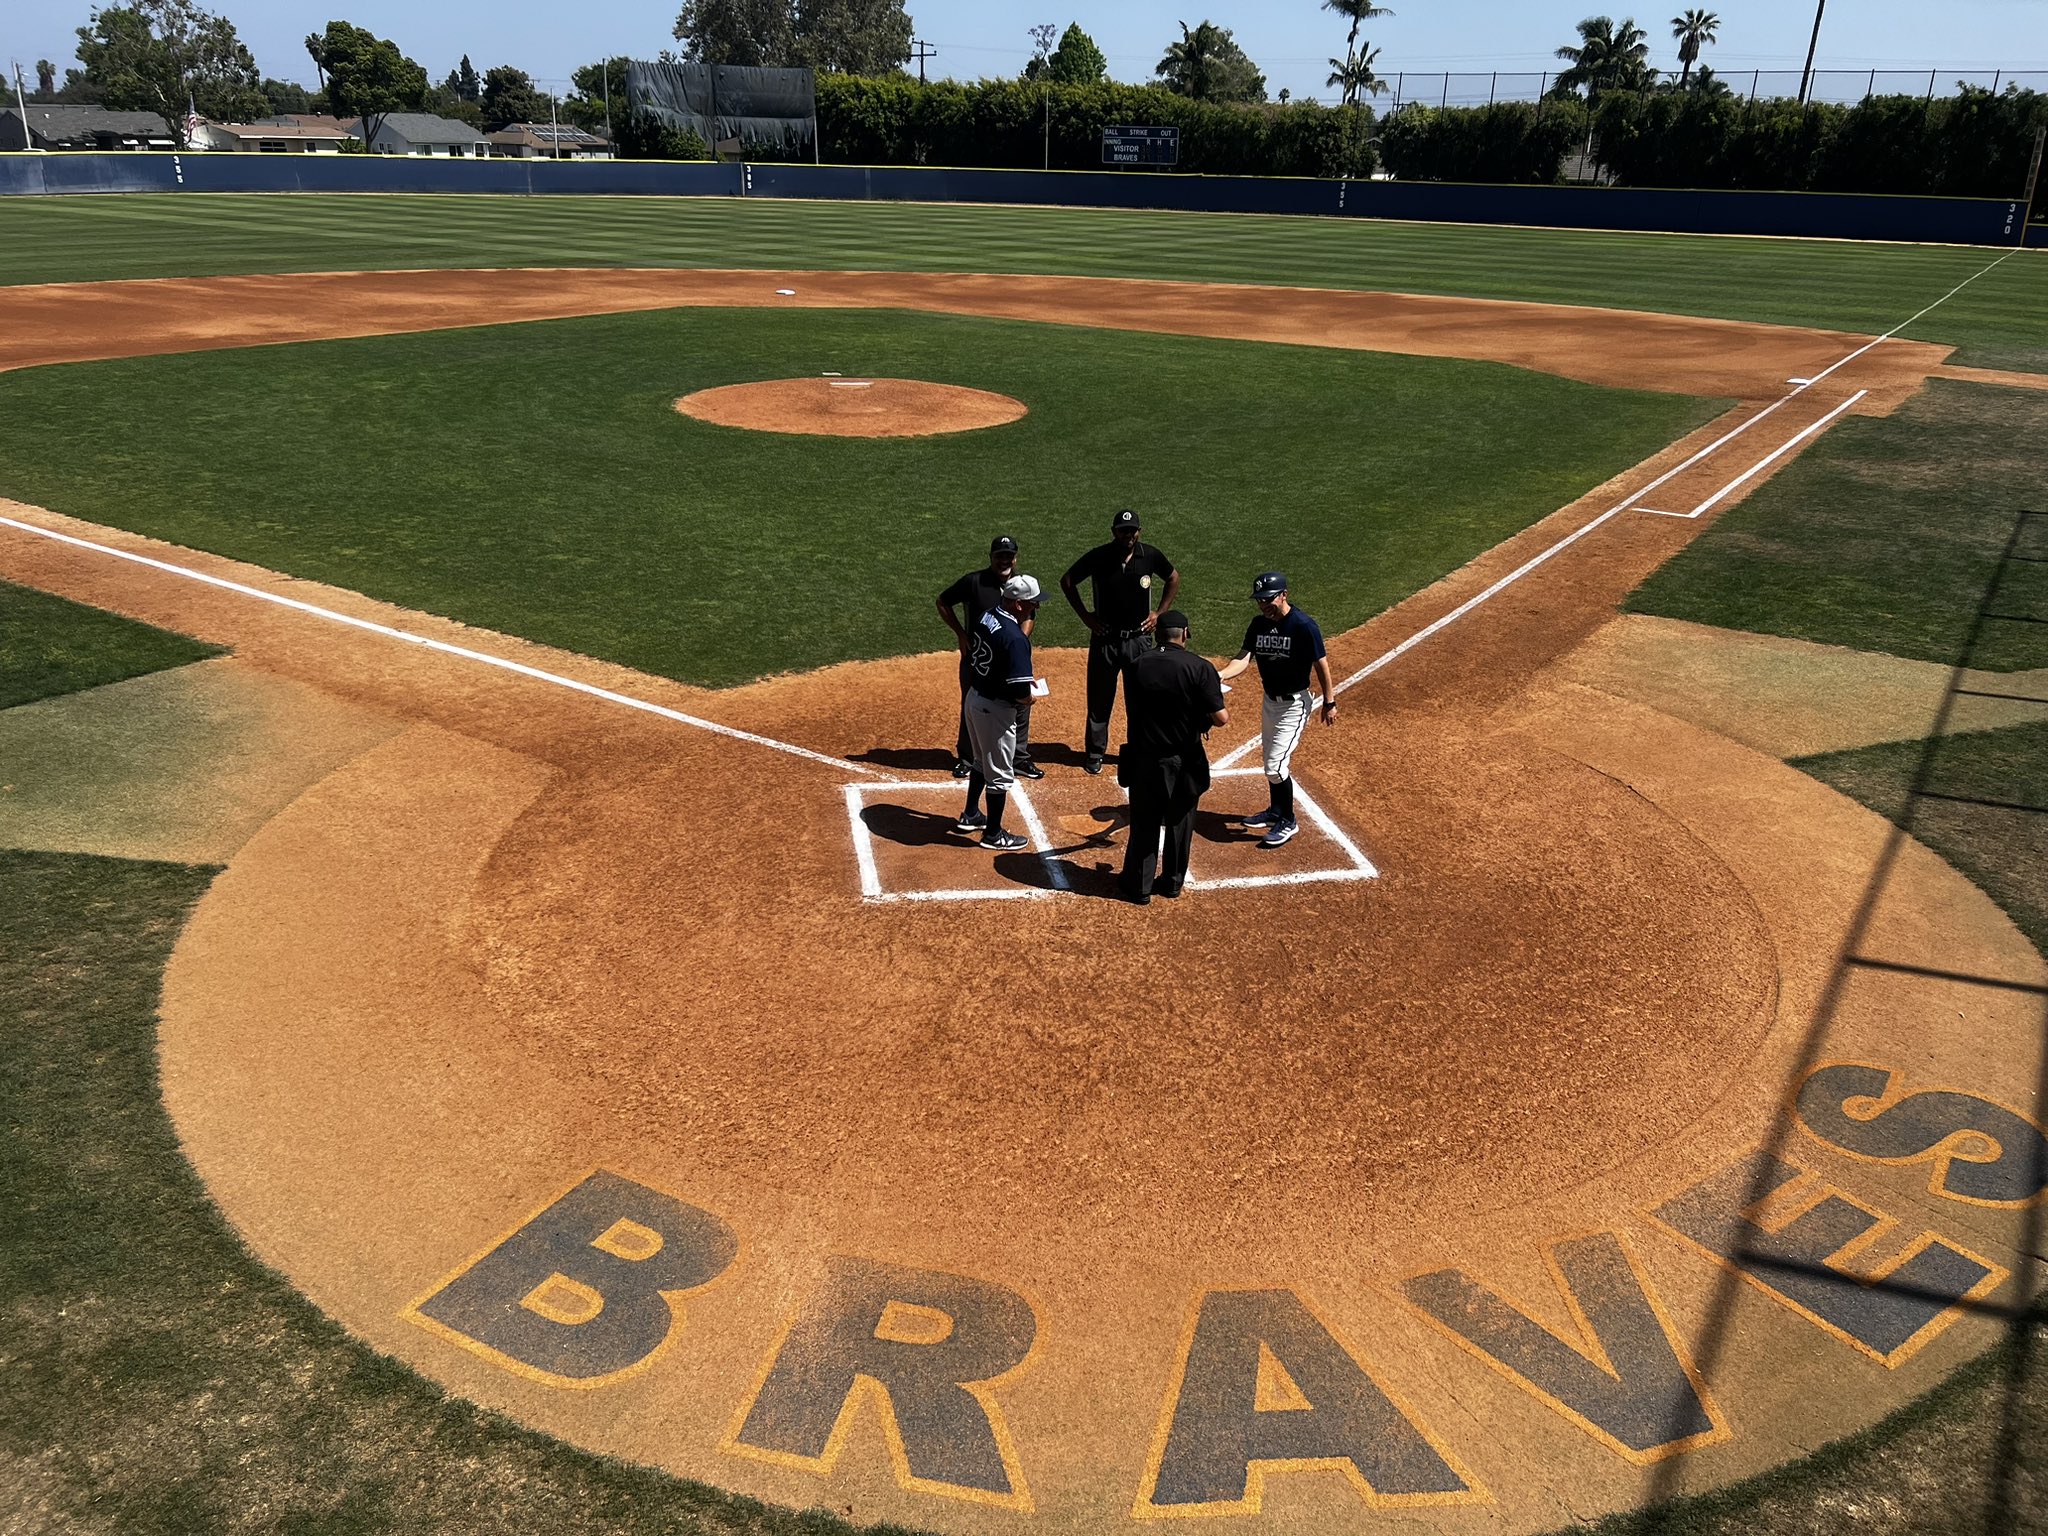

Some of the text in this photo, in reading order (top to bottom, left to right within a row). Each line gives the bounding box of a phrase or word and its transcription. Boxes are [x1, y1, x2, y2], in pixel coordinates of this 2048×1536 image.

[173, 155, 184, 183] 355
[2004, 203, 2015, 234] 320
[1256, 635, 1291, 649] BOSCO
[399, 1060, 2048, 1520] BRAVES
